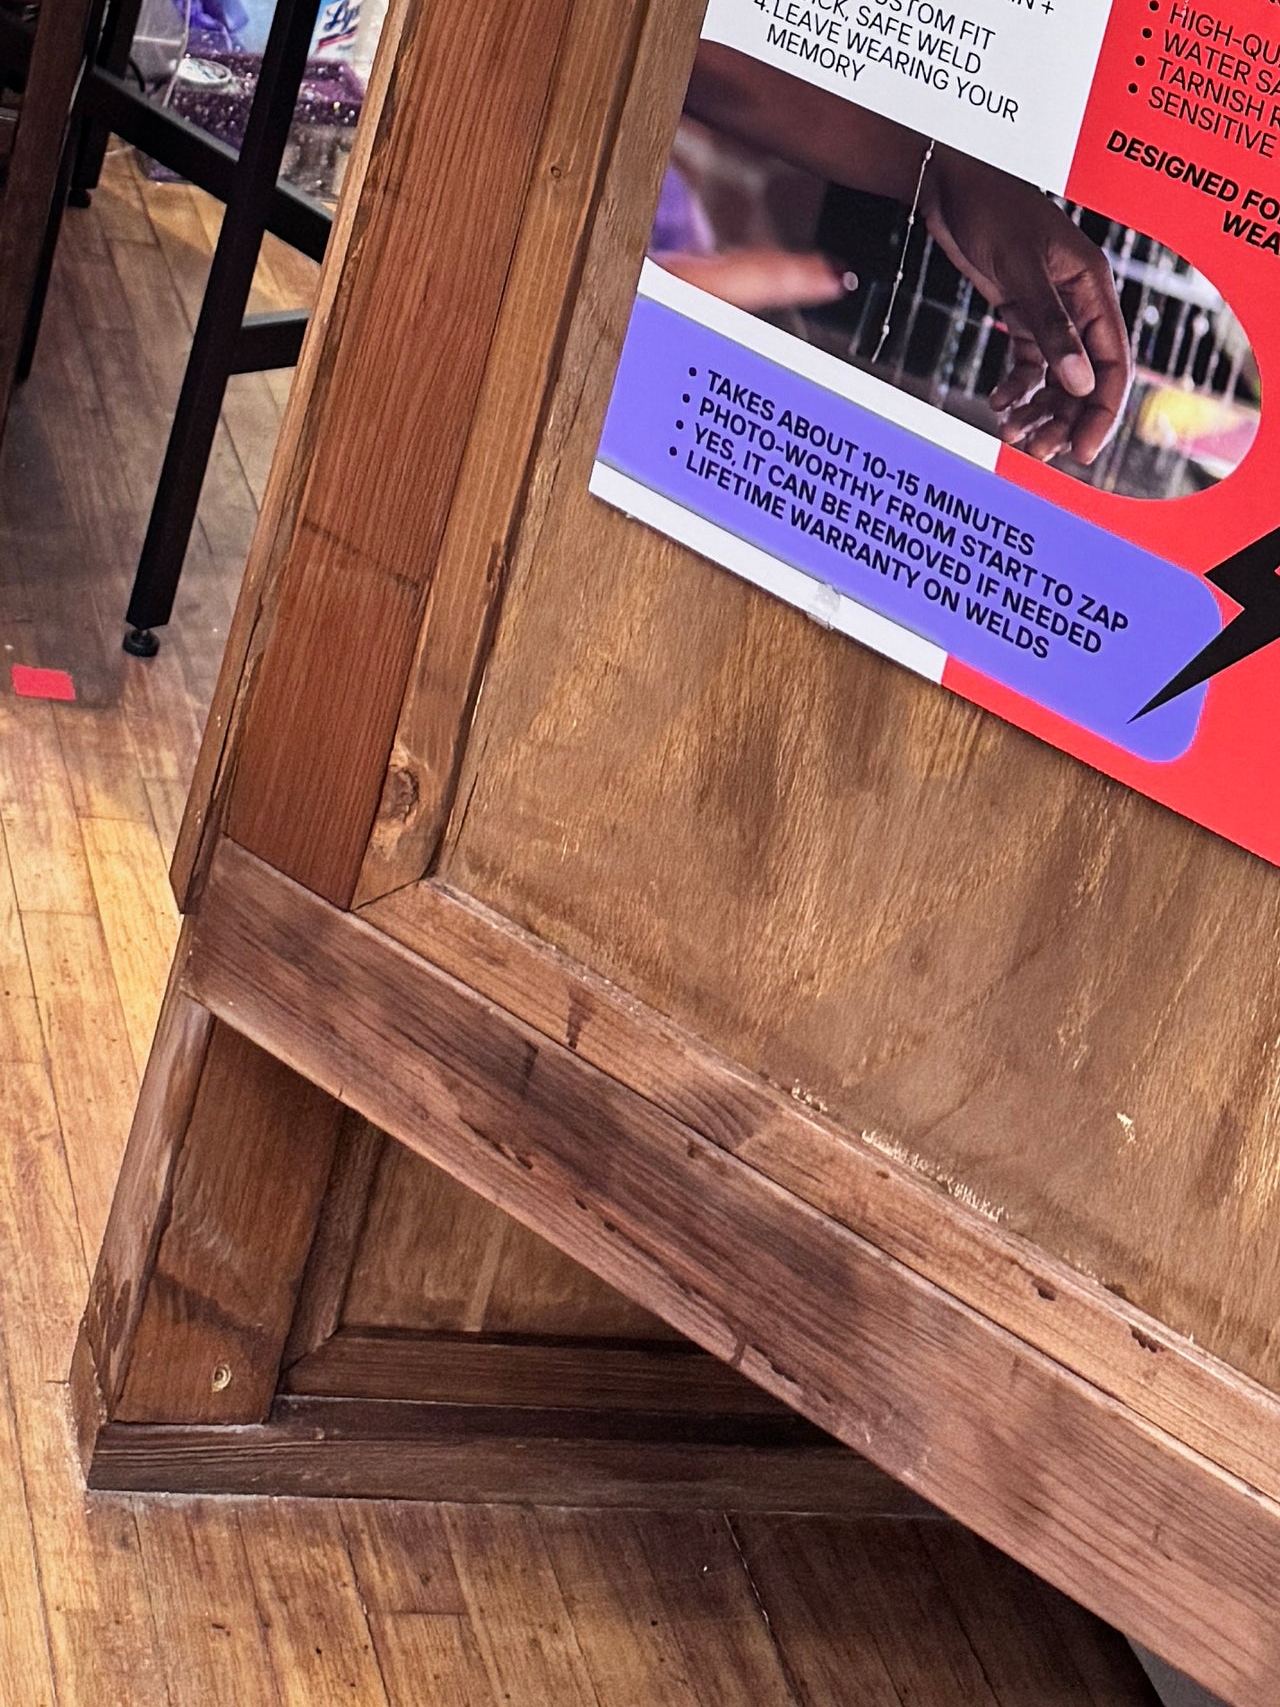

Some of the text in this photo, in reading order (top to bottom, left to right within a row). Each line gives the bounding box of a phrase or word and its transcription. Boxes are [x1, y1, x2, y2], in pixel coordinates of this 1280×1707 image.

[856, 5, 913, 46] SAFE
[918, 29, 981, 74] WELD
[959, 19, 996, 50] FIT
[1041, 0, 1055, 15] +
[766, 23, 866, 82] MEMORY
[847, 28, 950, 91] WEARING
[956, 76, 1019, 123] YOUR
[1164, 29, 1252, 85] WATER
[1148, 86, 1278, 159] SENSITIVE
[1158, 57, 1265, 122] TARNISH
[1106, 129, 1239, 202] DESIGNED
[708, 369, 1036, 556] TAKES ABOUT 10-15 MINUTES
[695, 422, 1102, 654] YES, IT CAN BE REMOVED IF NEEDED
[698, 396, 1129, 633] PHOTO-WORTHY FROM START TO ZAP
[685, 450, 1050, 659] LIFETIME WARRANTY ON WELDS
